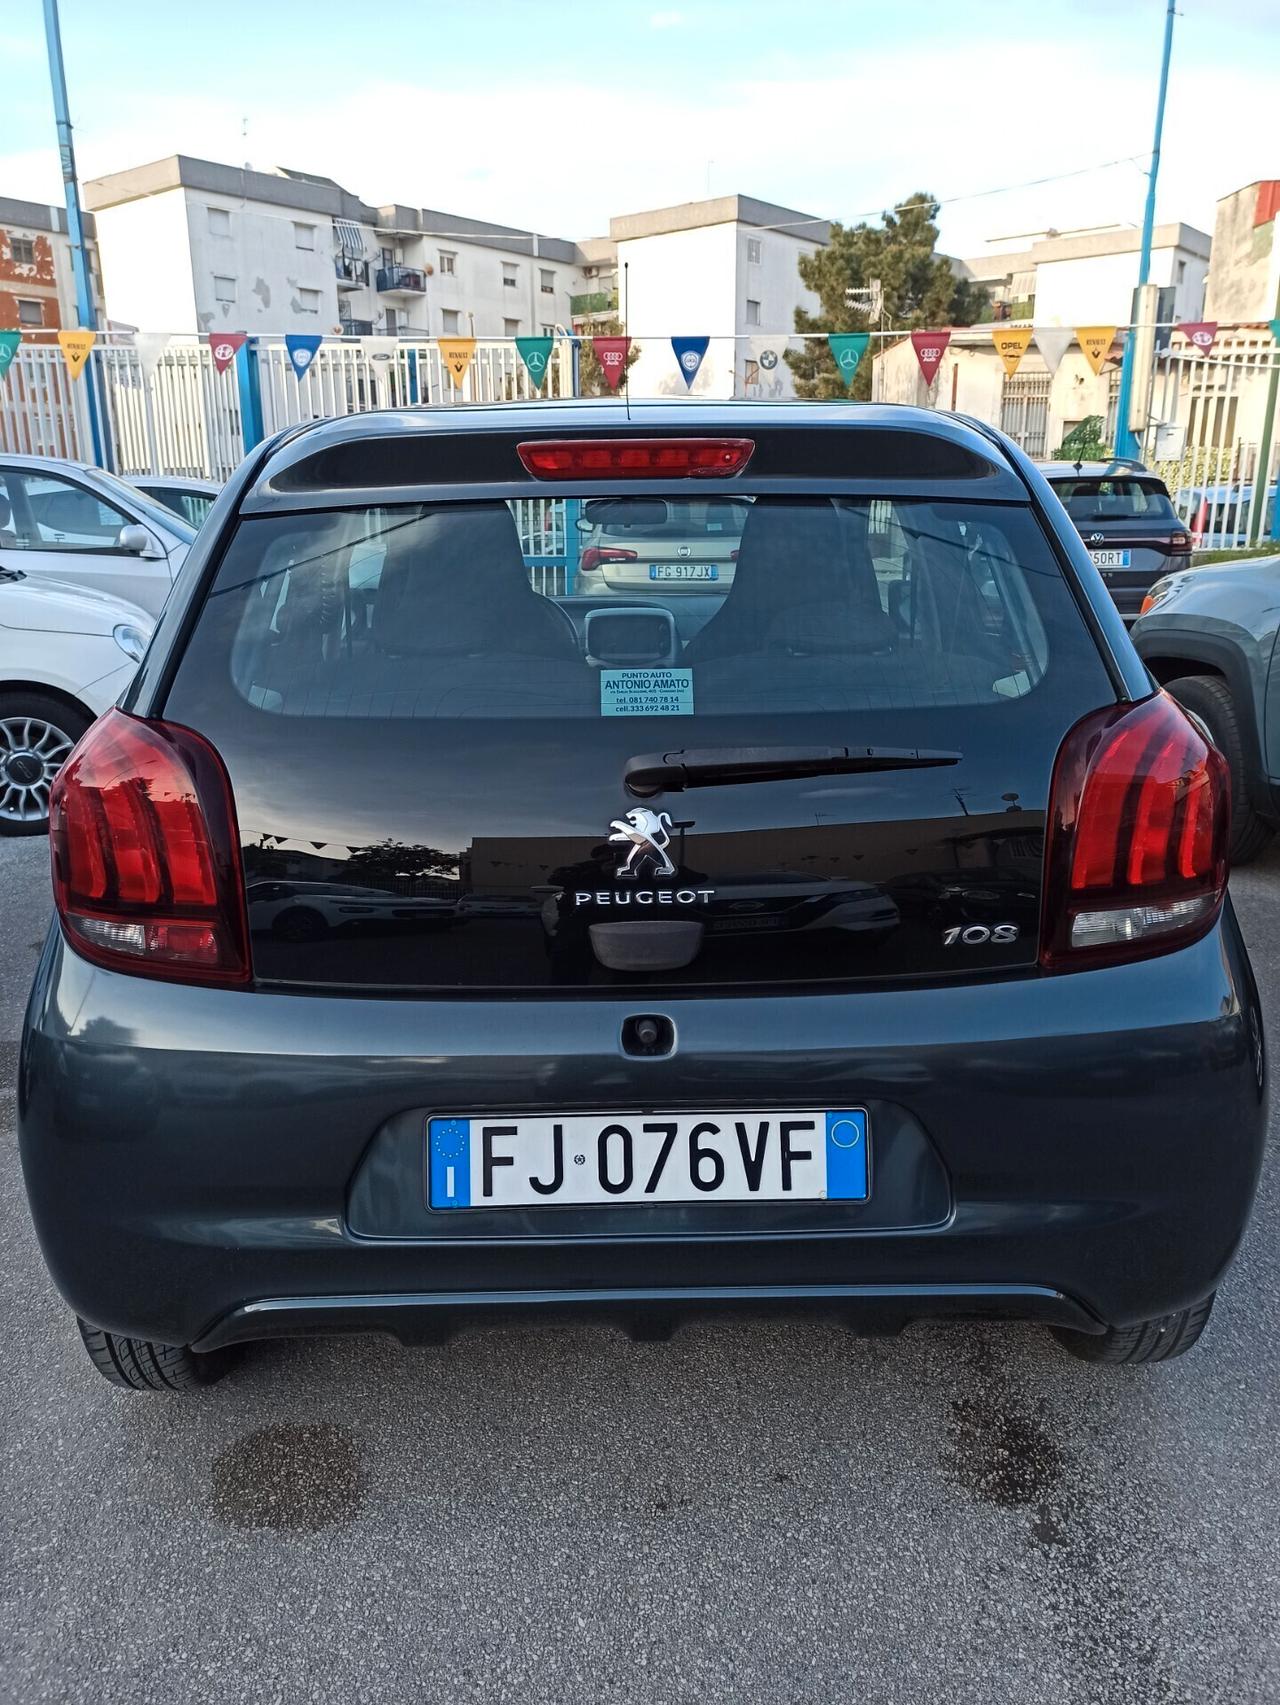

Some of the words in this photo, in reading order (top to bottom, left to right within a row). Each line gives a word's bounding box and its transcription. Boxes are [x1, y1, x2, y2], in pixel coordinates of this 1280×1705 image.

[1001, 342, 1022, 350] OPEL
[1090, 552, 1121, 564] 50RT
[605, 680, 651, 690] ANTONIO
[653, 678, 690, 689] AMATO
[575, 890, 715, 906] PEUGEOT
[944, 925, 1018, 945] 108
